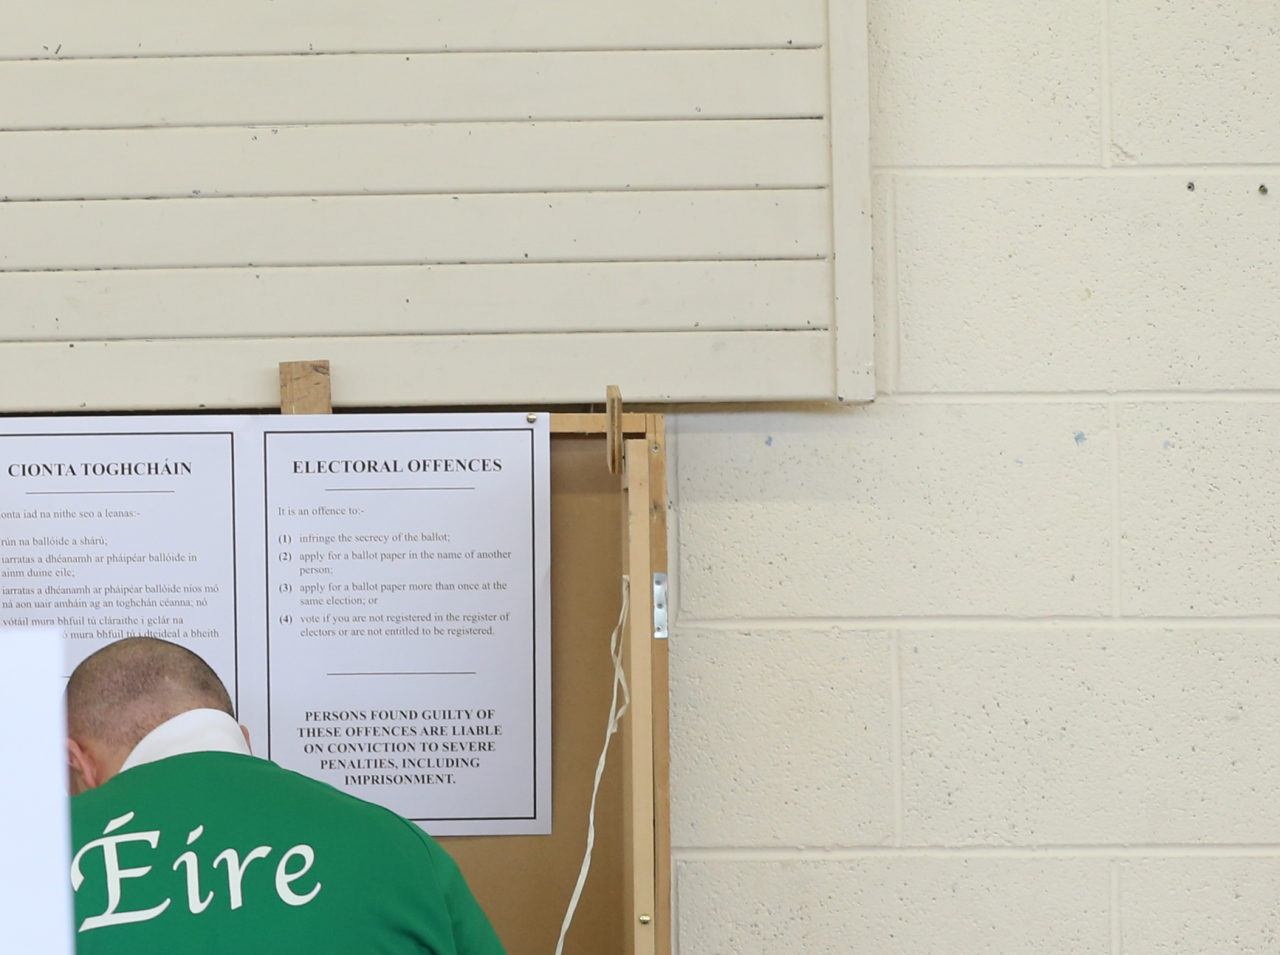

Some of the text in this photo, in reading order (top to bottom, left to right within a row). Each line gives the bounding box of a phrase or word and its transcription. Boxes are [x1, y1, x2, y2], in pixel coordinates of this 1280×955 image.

[8, 459, 192, 477] CIONTA TOGHCHÁIN
[293, 459, 502, 474] ELECTORAL OFFENCES
[23, 509, 37, 519] iad
[39, 511, 50, 519] na
[53, 509, 76, 519] nithe
[78, 511, 94, 519] seo
[278, 507, 284, 516] It
[287, 507, 295, 516] is
[297, 508, 308, 516] an
[311, 506, 346, 516] offence
[278, 533, 291, 545] (1)
[299, 533, 335, 545] infringe
[338, 533, 352, 542] the
[354, 535, 389, 544] secrecy
[391, 533, 403, 542] of
[404, 533, 418, 542] the
[278, 551, 291, 563] (2)
[299, 551, 324, 563] apply
[327, 551, 341, 560] for
[351, 551, 377, 560] ballot
[380, 553, 406, 562] paper
[408, 550, 417, 560] in
[420, 550, 434, 560] the
[436, 552, 462, 560] name
[464, 550, 476, 559] of
[476, 550, 512, 559] another
[300, 627, 335, 637] electors
[367, 627, 381, 636] not
[384, 627, 419, 636] entitled
[421, 627, 431, 636] to
[433, 626, 445, 636] be
[446, 626, 495, 638] registered.
[305, 709, 495, 721] PERSONS FOUND GUILTY OF
[298, 725, 503, 737] THESE OFFENCES ARE LIABLE
[303, 741, 496, 753] ON CONVICTION TO SEVERE
[320, 758, 480, 770] PENALTIES, INCLUDING
[345, 774, 456, 785] IMPRISONMENT.
[70, 811, 321, 933] Éire
